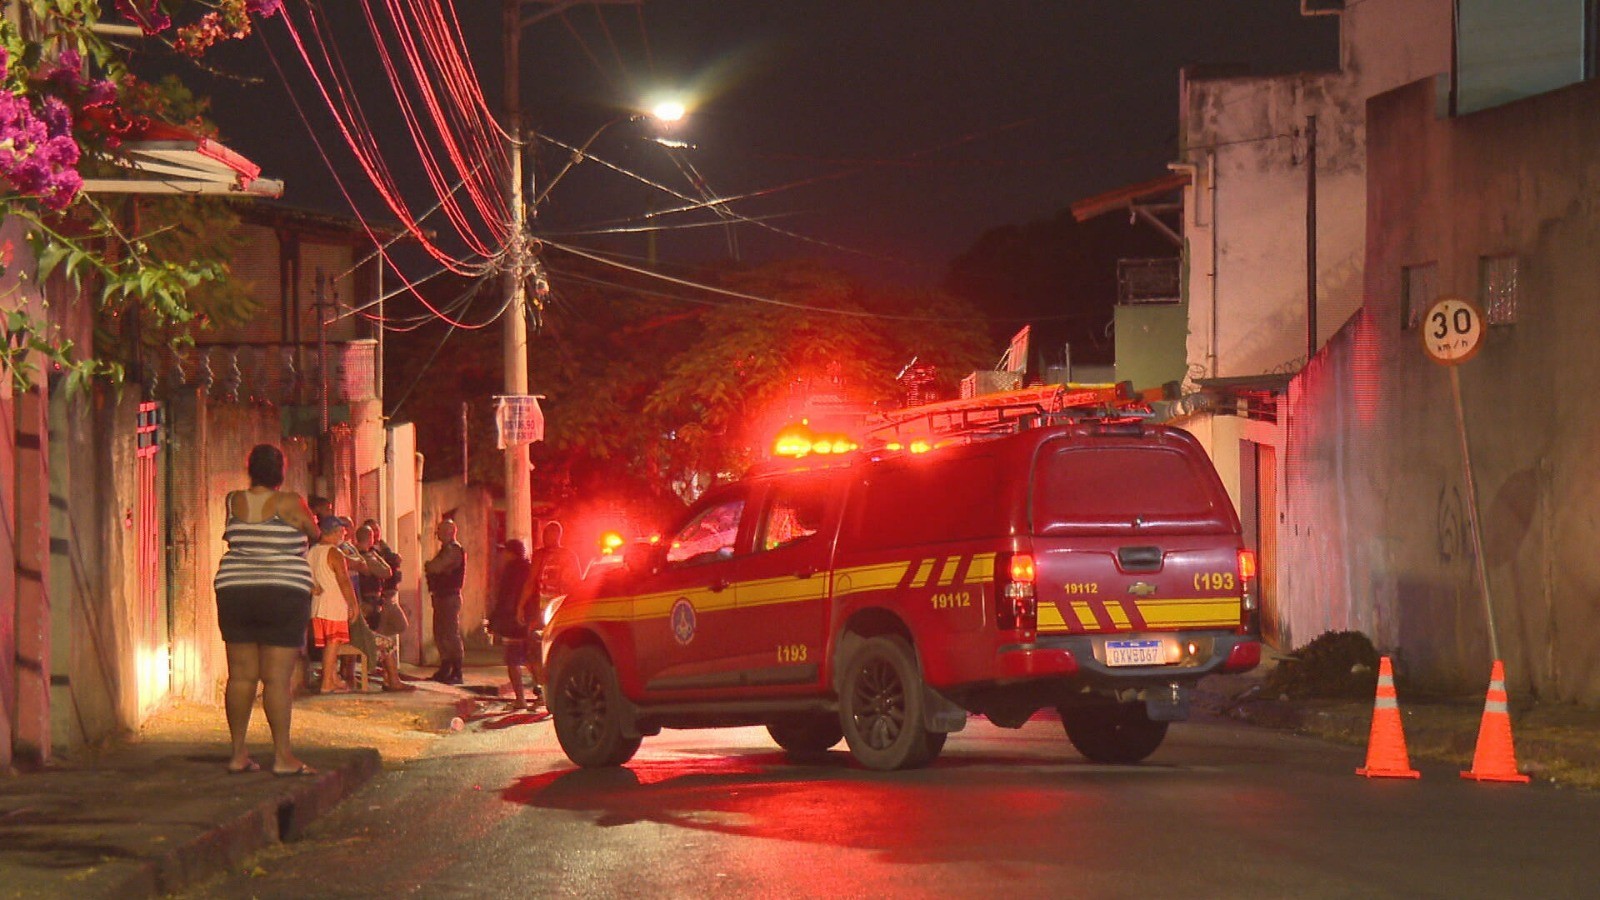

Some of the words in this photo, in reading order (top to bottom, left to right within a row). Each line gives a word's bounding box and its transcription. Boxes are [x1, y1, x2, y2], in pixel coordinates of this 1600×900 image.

[1432, 308, 1471, 339] 30
[1437, 339, 1468, 351] km/h
[1064, 583, 1098, 594] 19112
[1201, 572, 1234, 590] 193
[931, 592, 970, 609] 19112
[783, 644, 807, 661] 193
